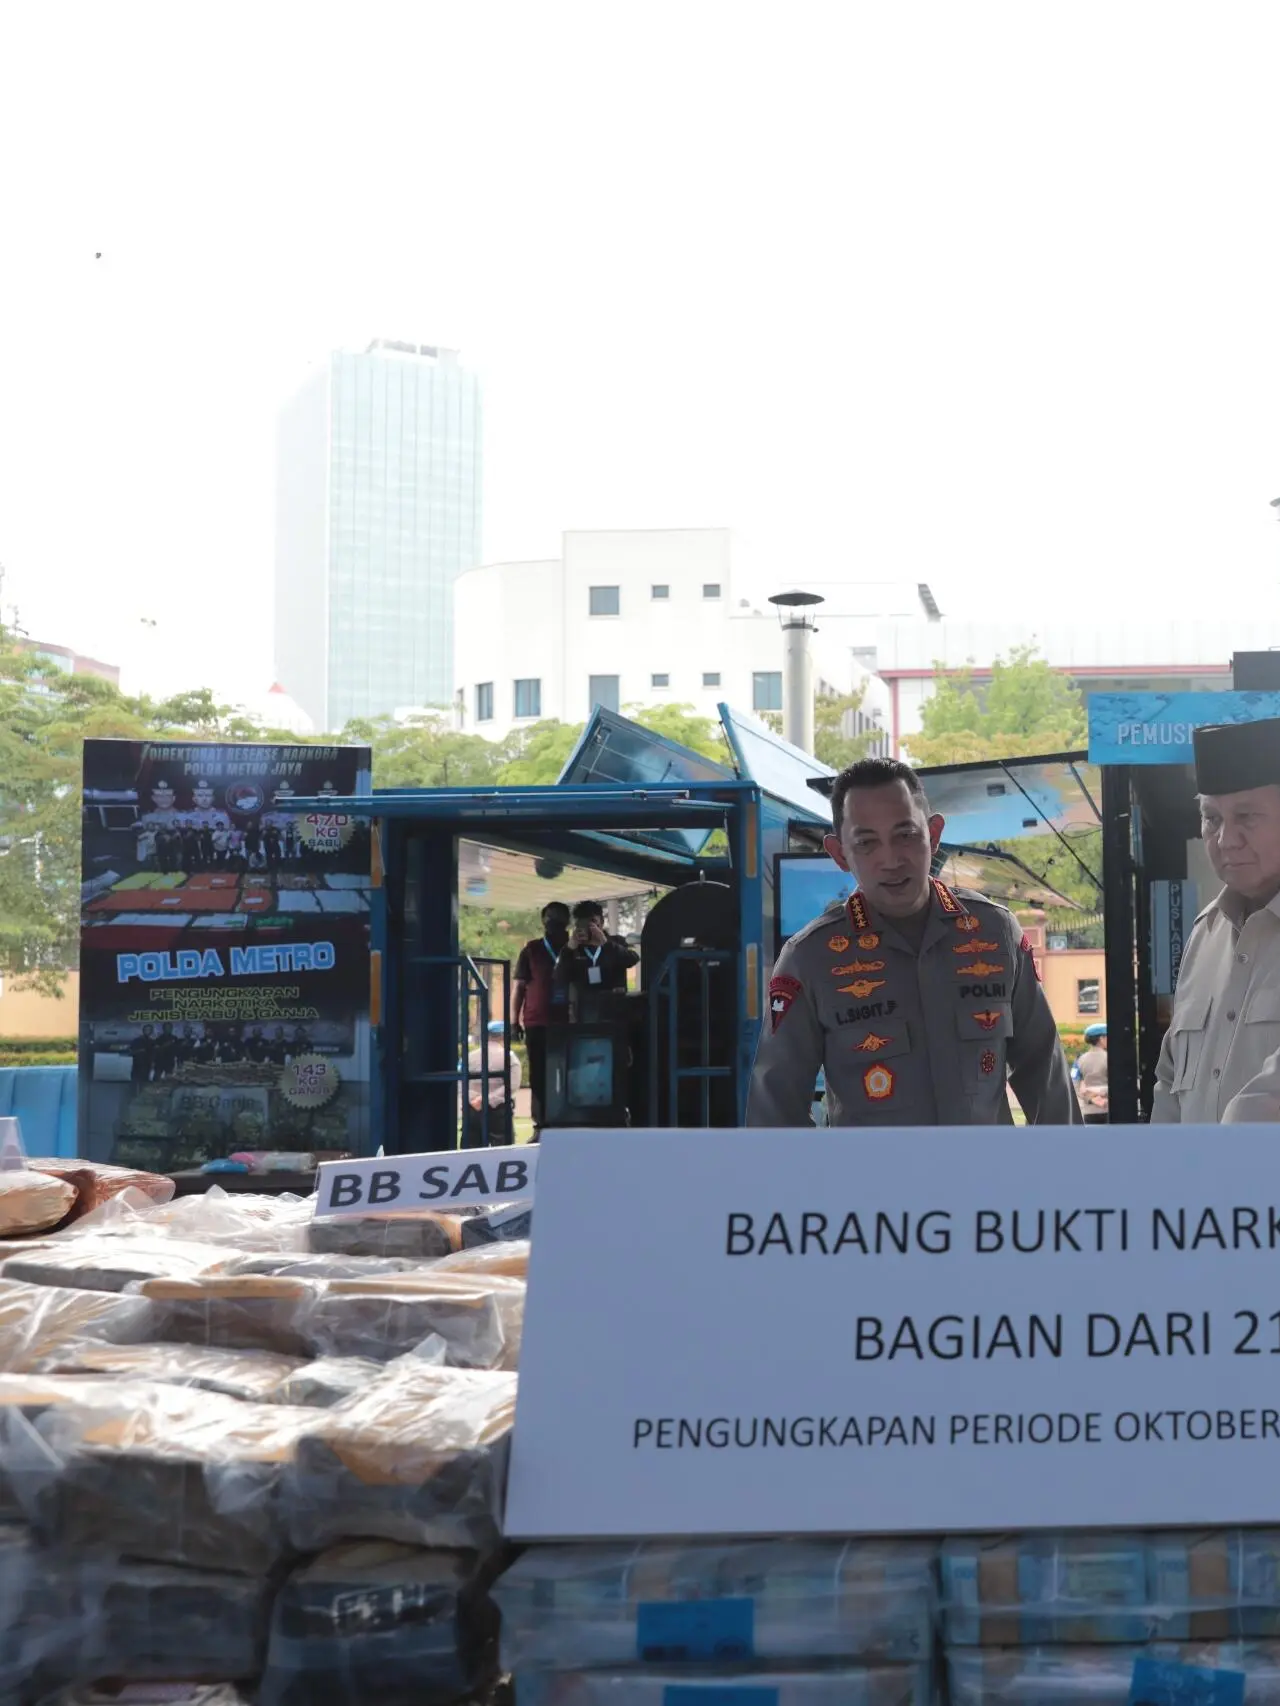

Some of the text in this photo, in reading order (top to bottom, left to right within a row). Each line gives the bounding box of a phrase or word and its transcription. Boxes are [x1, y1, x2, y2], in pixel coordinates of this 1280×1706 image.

[1117, 722, 1205, 745] PEMUSN
[315, 828, 339, 838] KG
[308, 838, 343, 848] SABU
[116, 941, 336, 983] POLDA METRO
[150, 986, 300, 1001] PENGUNGKAPAN
[960, 981, 1006, 998] POLRI
[173, 999, 278, 1011] NARKOTIKA
[128, 1010, 182, 1022] JENIS
[184, 1010, 238, 1021] SABU
[258, 1008, 320, 1020] GANJA
[292, 1063, 327, 1076] 143
[298, 1076, 319, 1087] KG
[289, 1087, 331, 1097] GANJA
[329, 1160, 529, 1207] BB SAB
[727, 1211, 952, 1255] BARANG
[975, 1209, 1128, 1252] BUKTI
[855, 1314, 1062, 1360] BAGIAN
[1087, 1312, 1210, 1357] DARI
[633, 1416, 935, 1448] PENGUNGKAPAN
[950, 1413, 1102, 1444] PERIODE
[1114, 1410, 1280, 1442] OKTOBER
